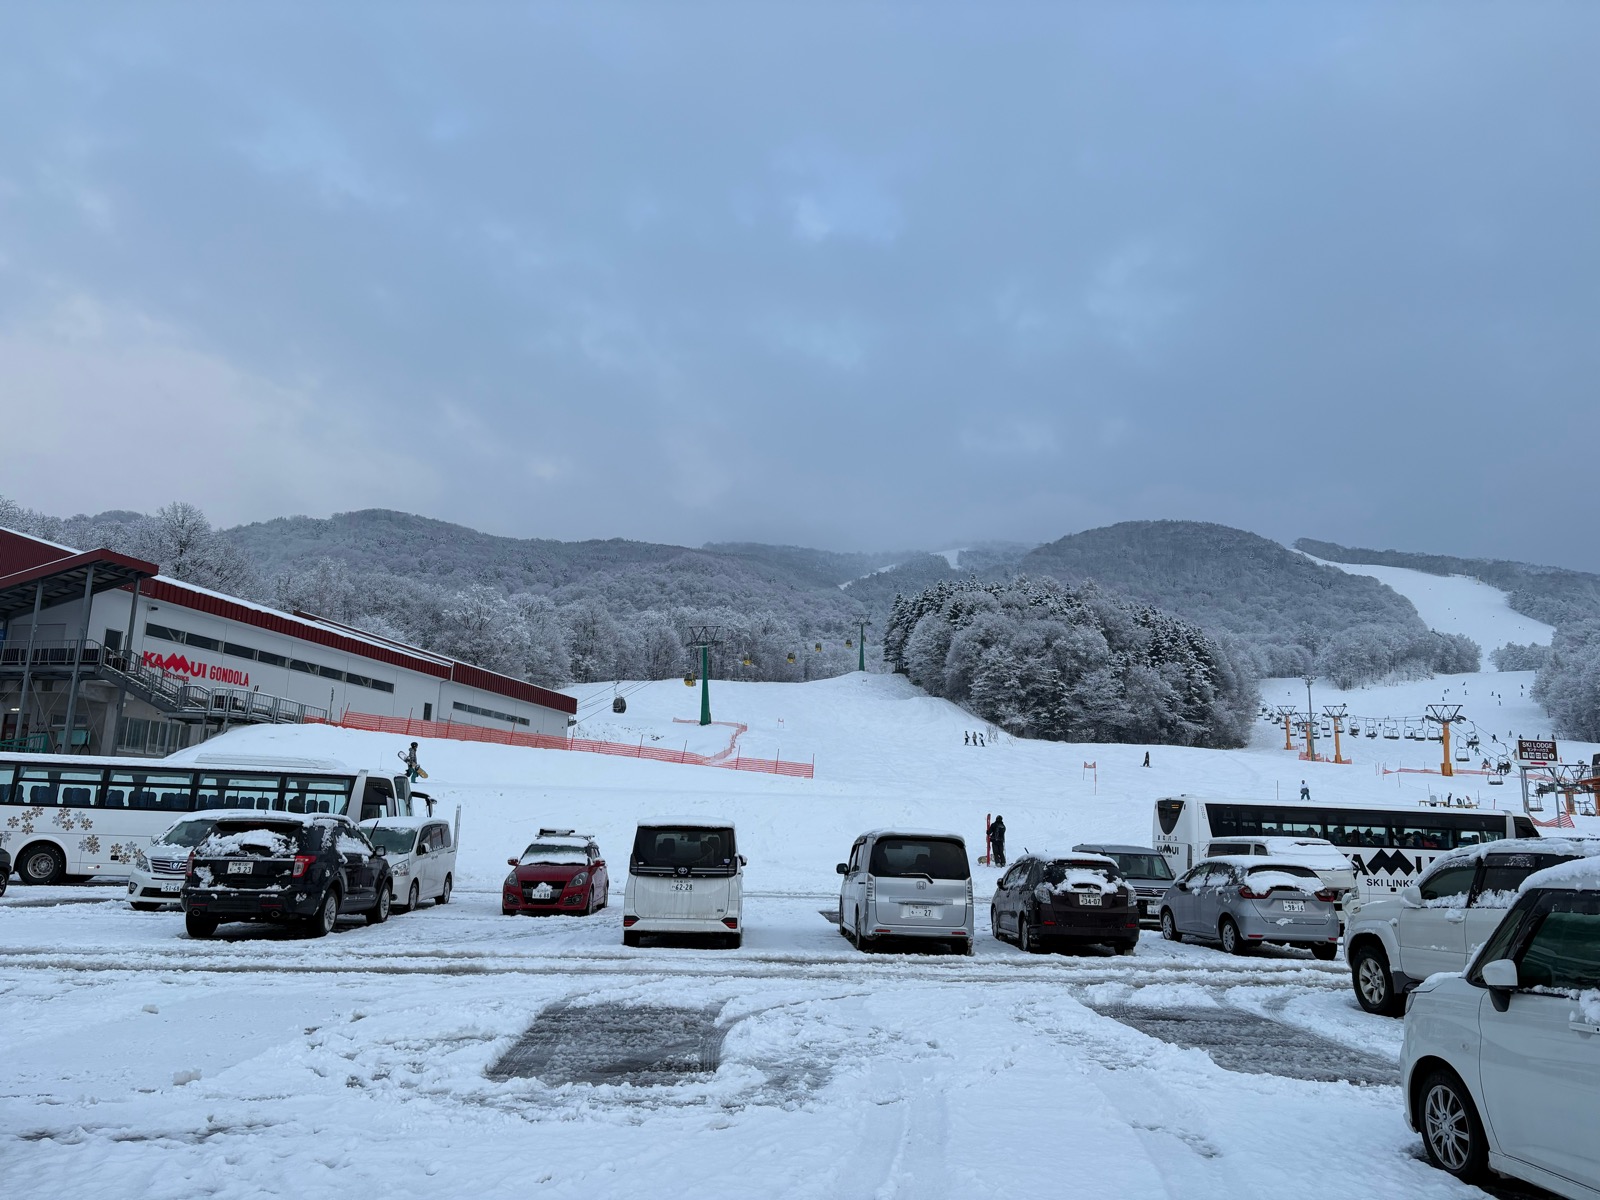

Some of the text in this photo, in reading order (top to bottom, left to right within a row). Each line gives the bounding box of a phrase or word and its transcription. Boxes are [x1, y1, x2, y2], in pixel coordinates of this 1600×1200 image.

[143, 651, 249, 687] KAMUI GONDOLA
[675, 883, 693, 891] 62-28
[1366, 878, 1384, 887] SKI
